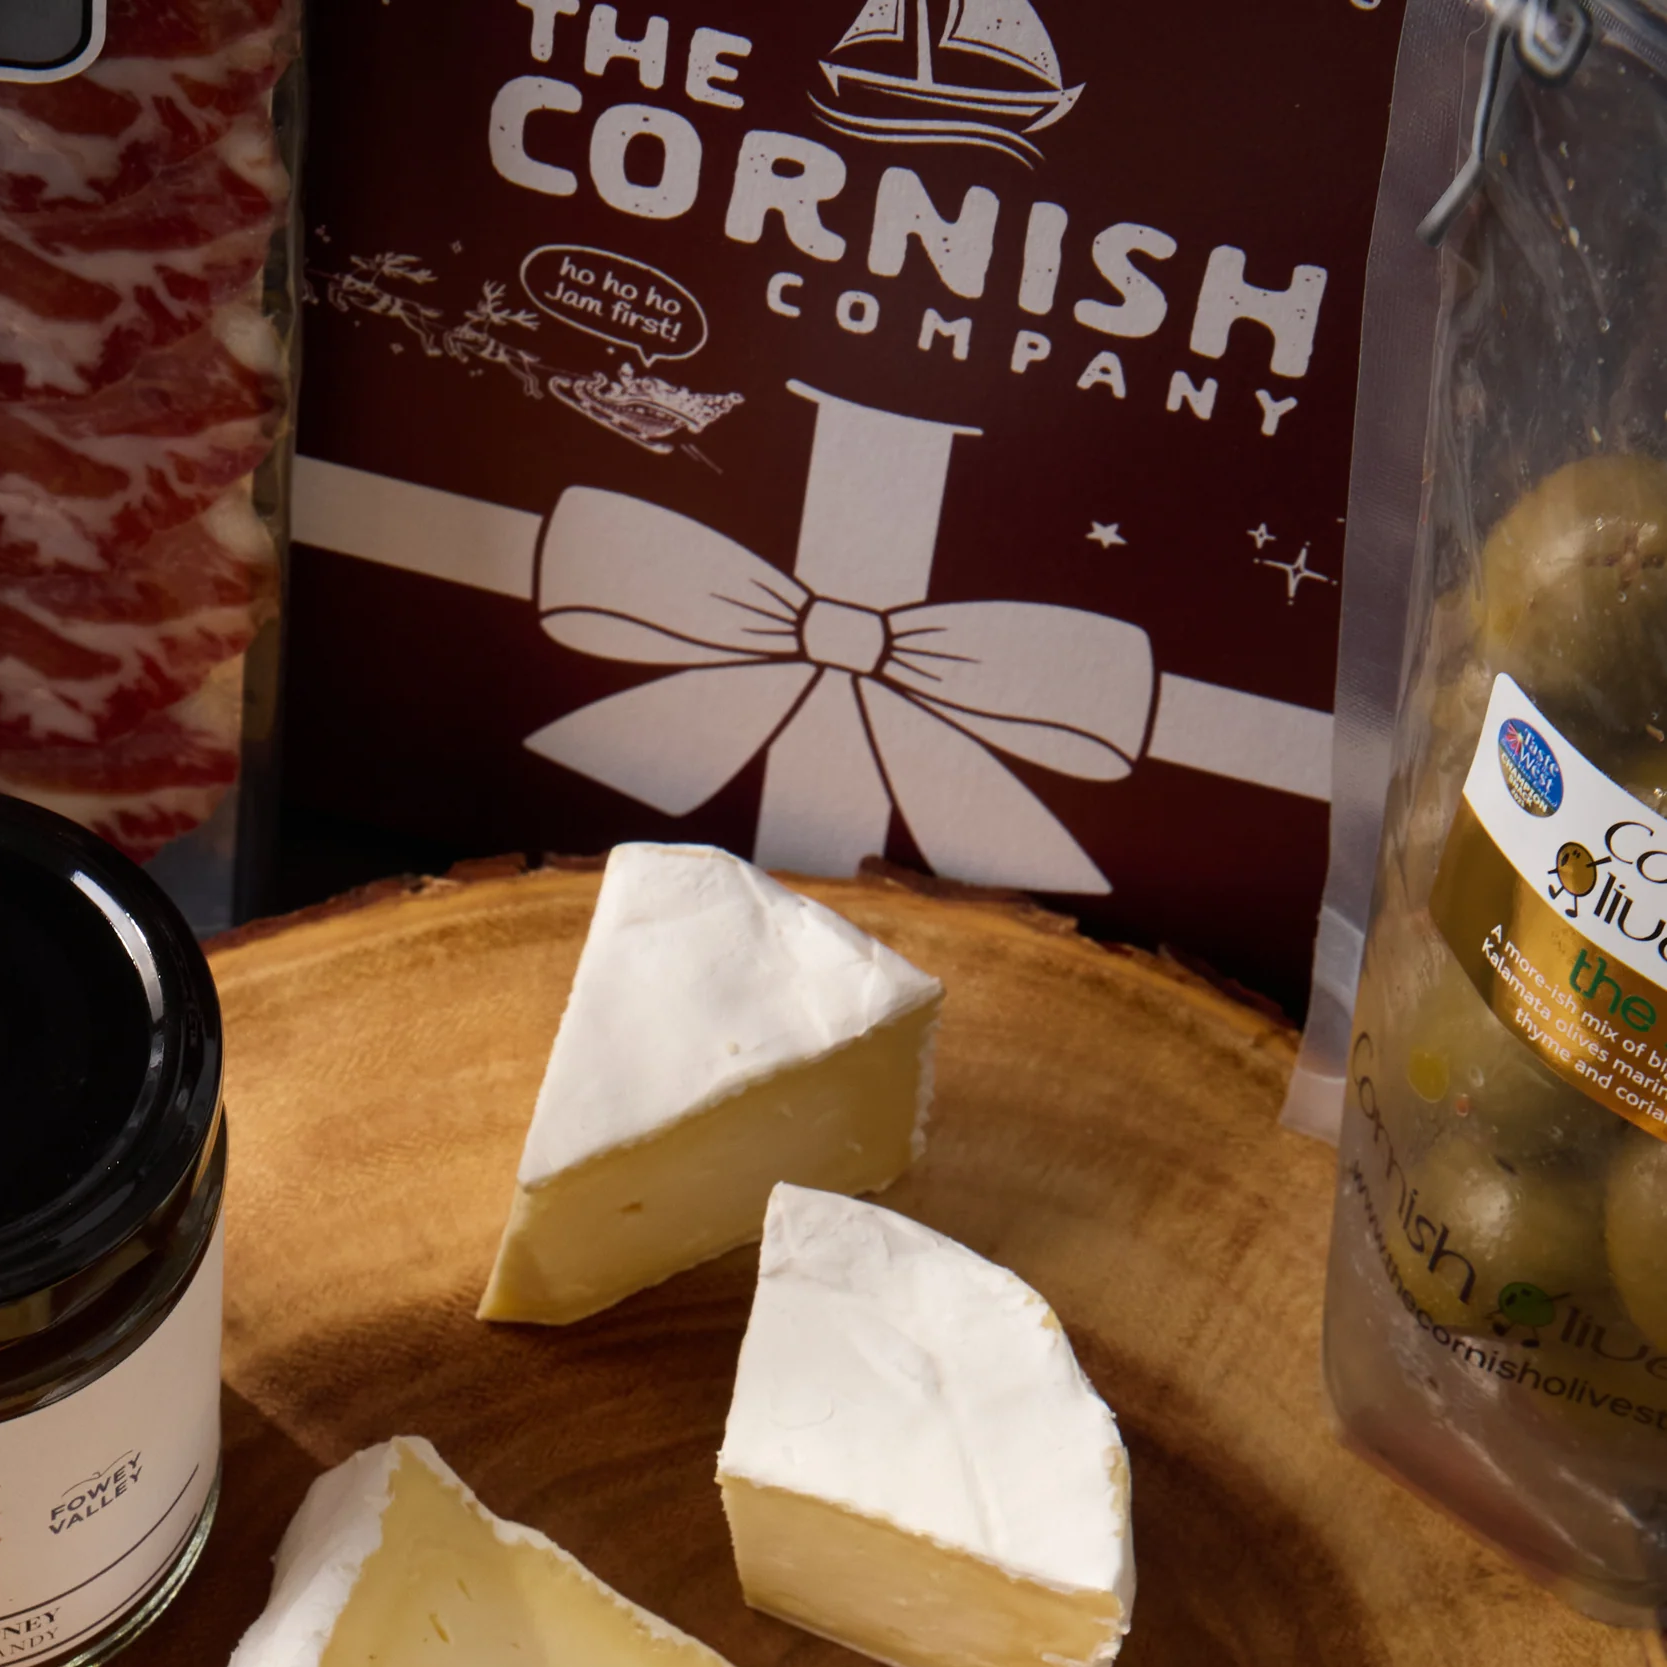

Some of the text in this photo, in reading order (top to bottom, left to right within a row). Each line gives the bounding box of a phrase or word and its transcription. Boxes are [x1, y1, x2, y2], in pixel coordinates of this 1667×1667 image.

[516, 0, 752, 108] THE
[489, 75, 1327, 378] CORNISH
[543, 281, 682, 343] Jam first!
[559, 256, 681, 315] ho ho ho
[766, 271, 1298, 436] COMPANY
[1481, 936, 1552, 1022] Kalamata
[1555, 1014, 1609, 1063] olives
[1490, 924, 1503, 944] A
[1504, 938, 1578, 1016] more-ish
[1581, 1010, 1620, 1043] mix
[1622, 1038, 1647, 1058] of
[1568, 948, 1657, 1033] the
[1514, 1008, 1667, 1125] thyme and coria
[48, 1465, 143, 1535] VALLEY
[50, 1450, 142, 1521] FOWEY
